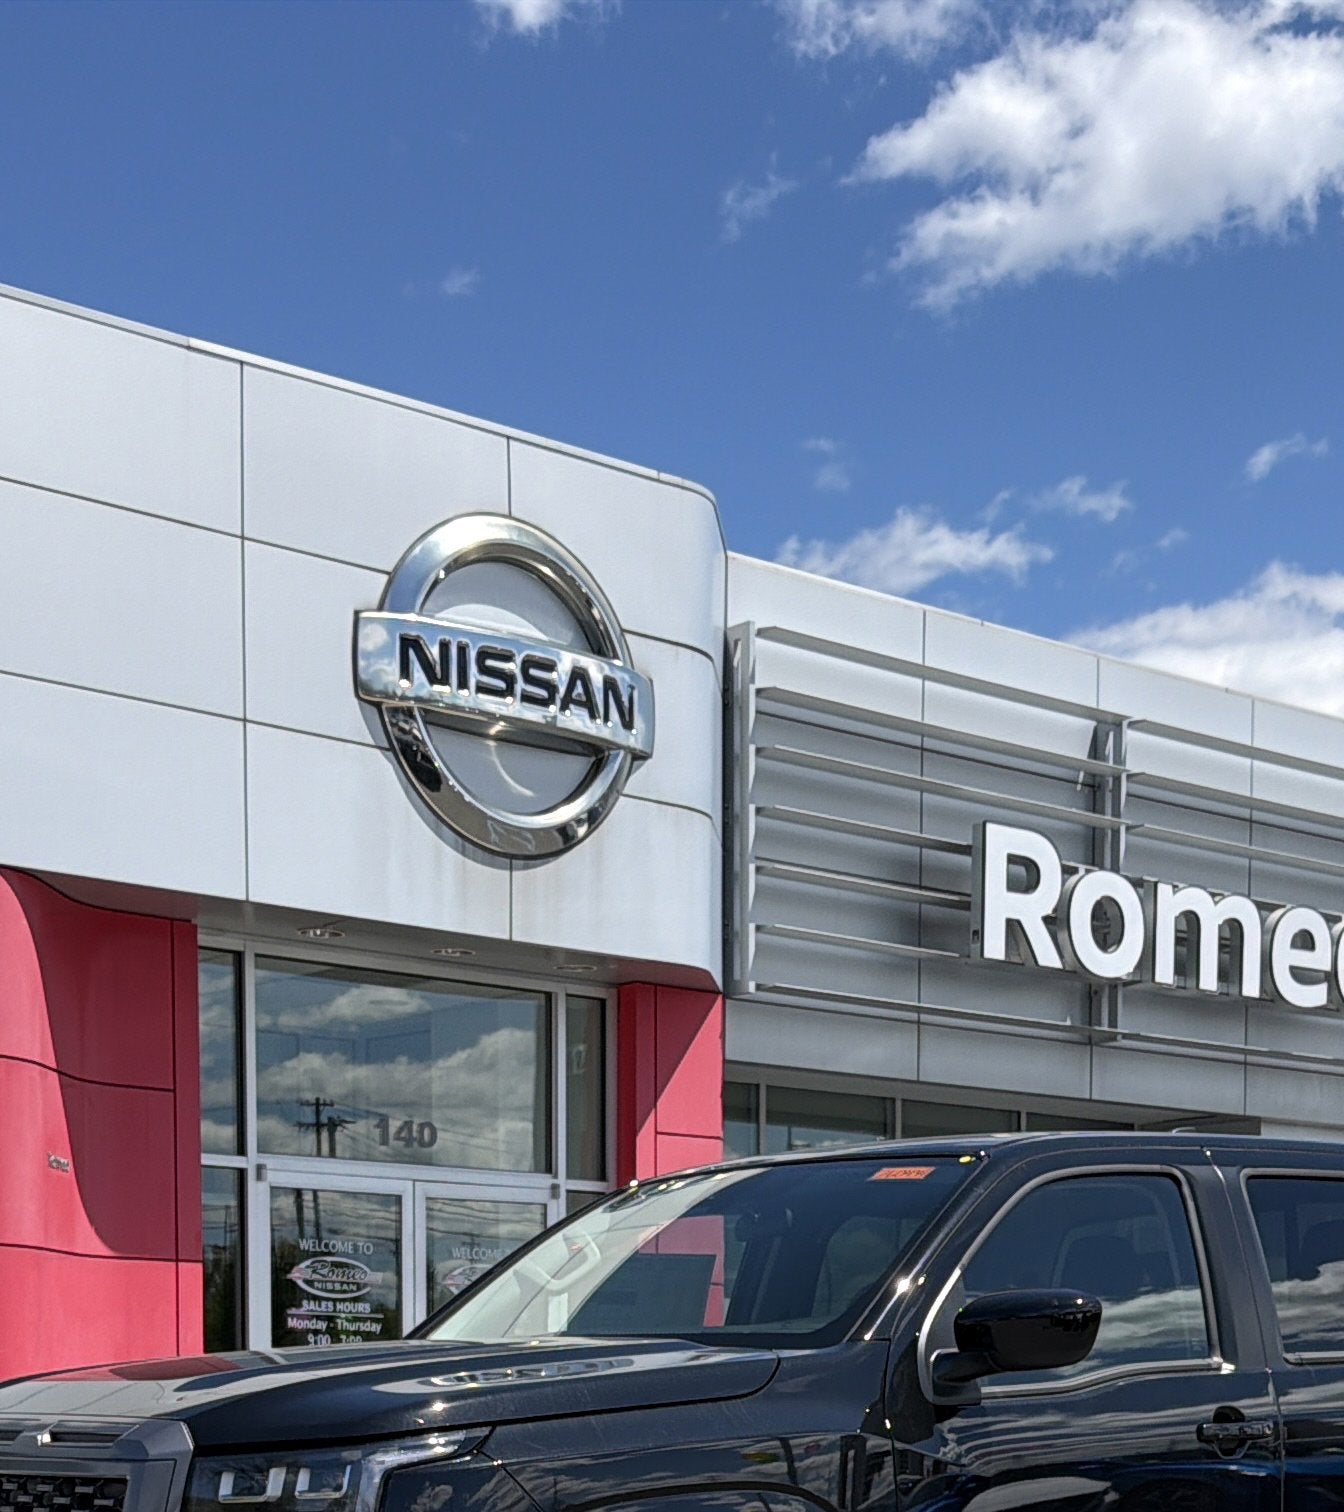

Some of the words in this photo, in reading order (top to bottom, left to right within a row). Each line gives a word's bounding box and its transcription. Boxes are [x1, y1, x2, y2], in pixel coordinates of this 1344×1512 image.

[399, 632, 637, 734] NISSAN
[373, 1118, 438, 1149] 140
[299, 1238, 355, 1253] WELCOME
[357, 1241, 374, 1255] TO
[305, 1259, 369, 1281] Romeo
[314, 1281, 357, 1291] NISSAN
[301, 1299, 334, 1312] SALES
[336, 1301, 371, 1313] HOURS
[287, 1316, 328, 1332] Monday
[336, 1318, 383, 1334] Thursday
[307, 1333, 331, 1345] 9:00
